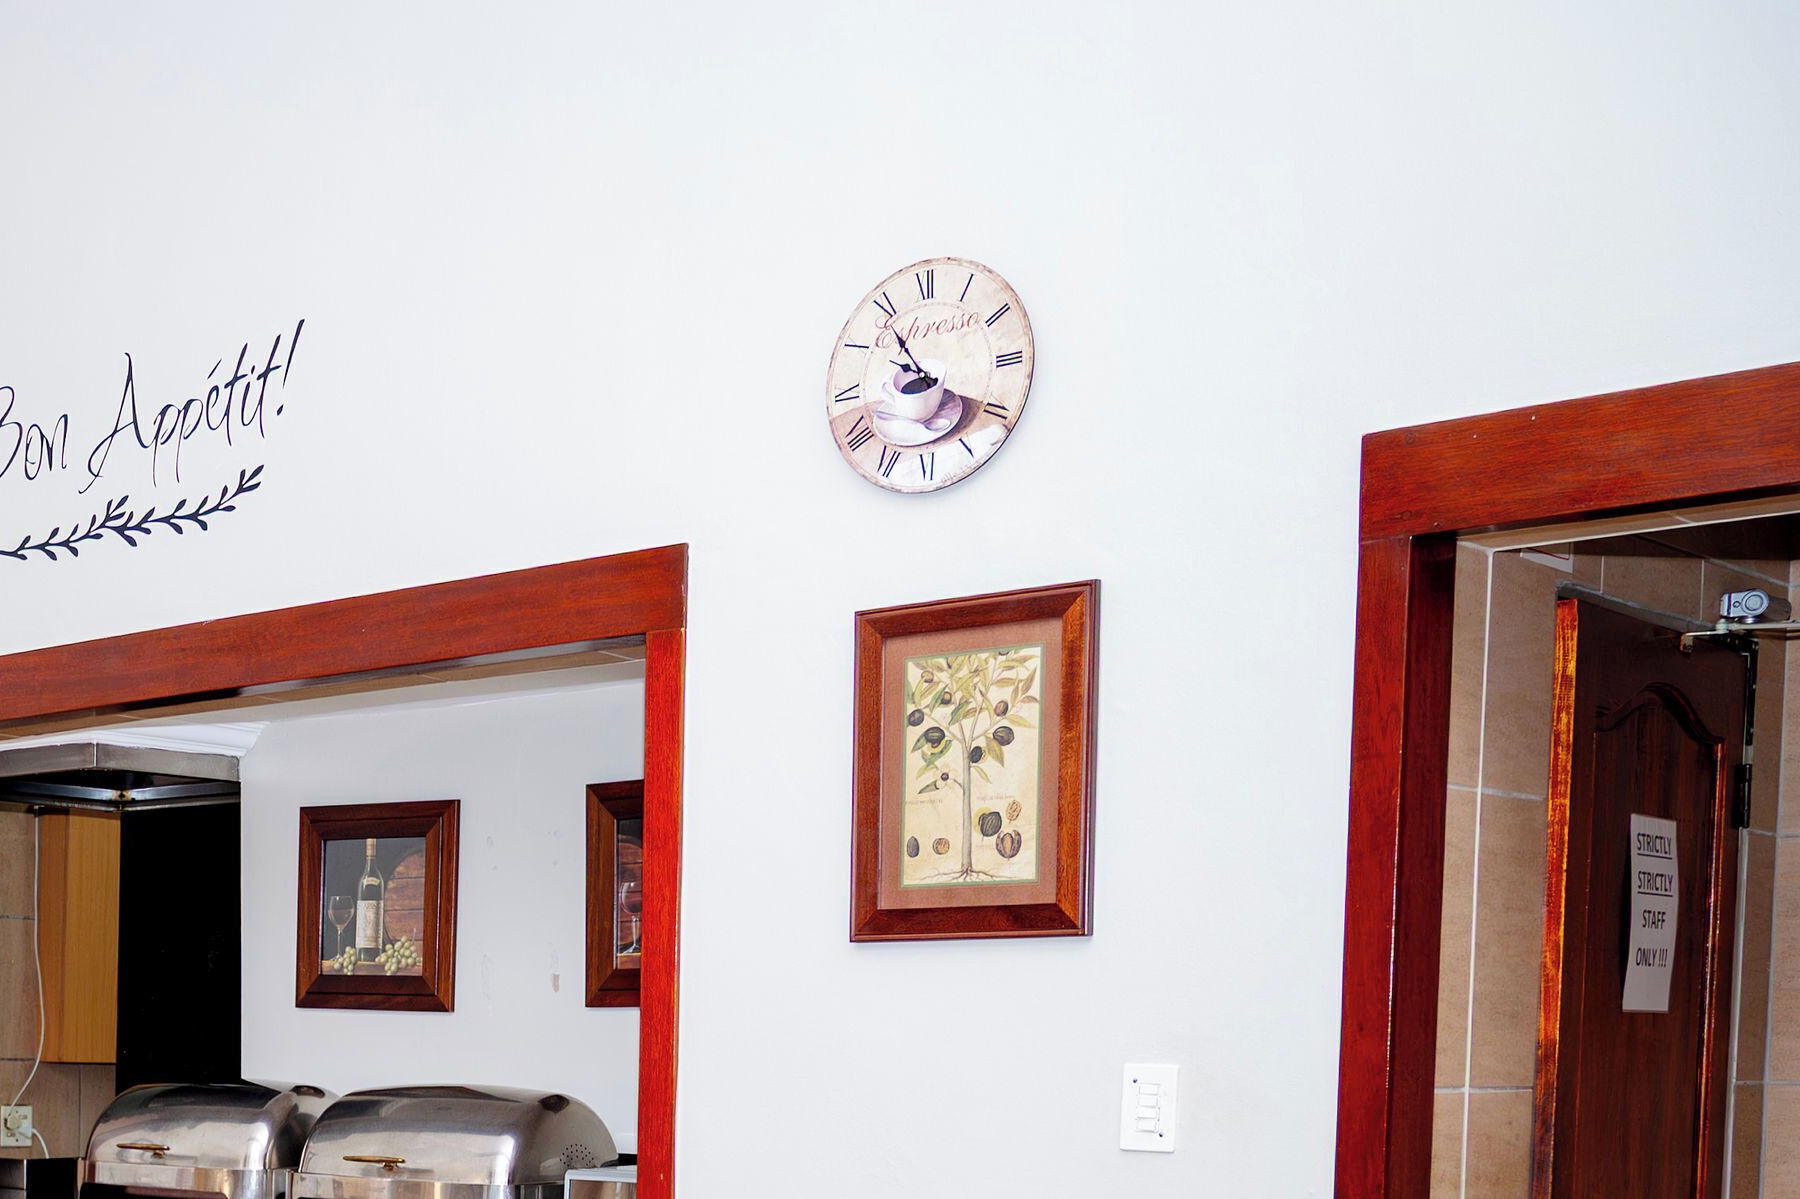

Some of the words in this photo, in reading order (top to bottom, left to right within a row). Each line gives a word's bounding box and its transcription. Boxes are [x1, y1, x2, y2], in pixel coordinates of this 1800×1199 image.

[875, 310, 983, 356] Espresso
[78, 318, 306, 494] Appétit!
[1636, 832, 1672, 856] STRICTLY
[1637, 870, 1674, 893] STRICTLY
[1641, 909, 1667, 930] STAFF
[1635, 947, 1657, 967] ONLY
